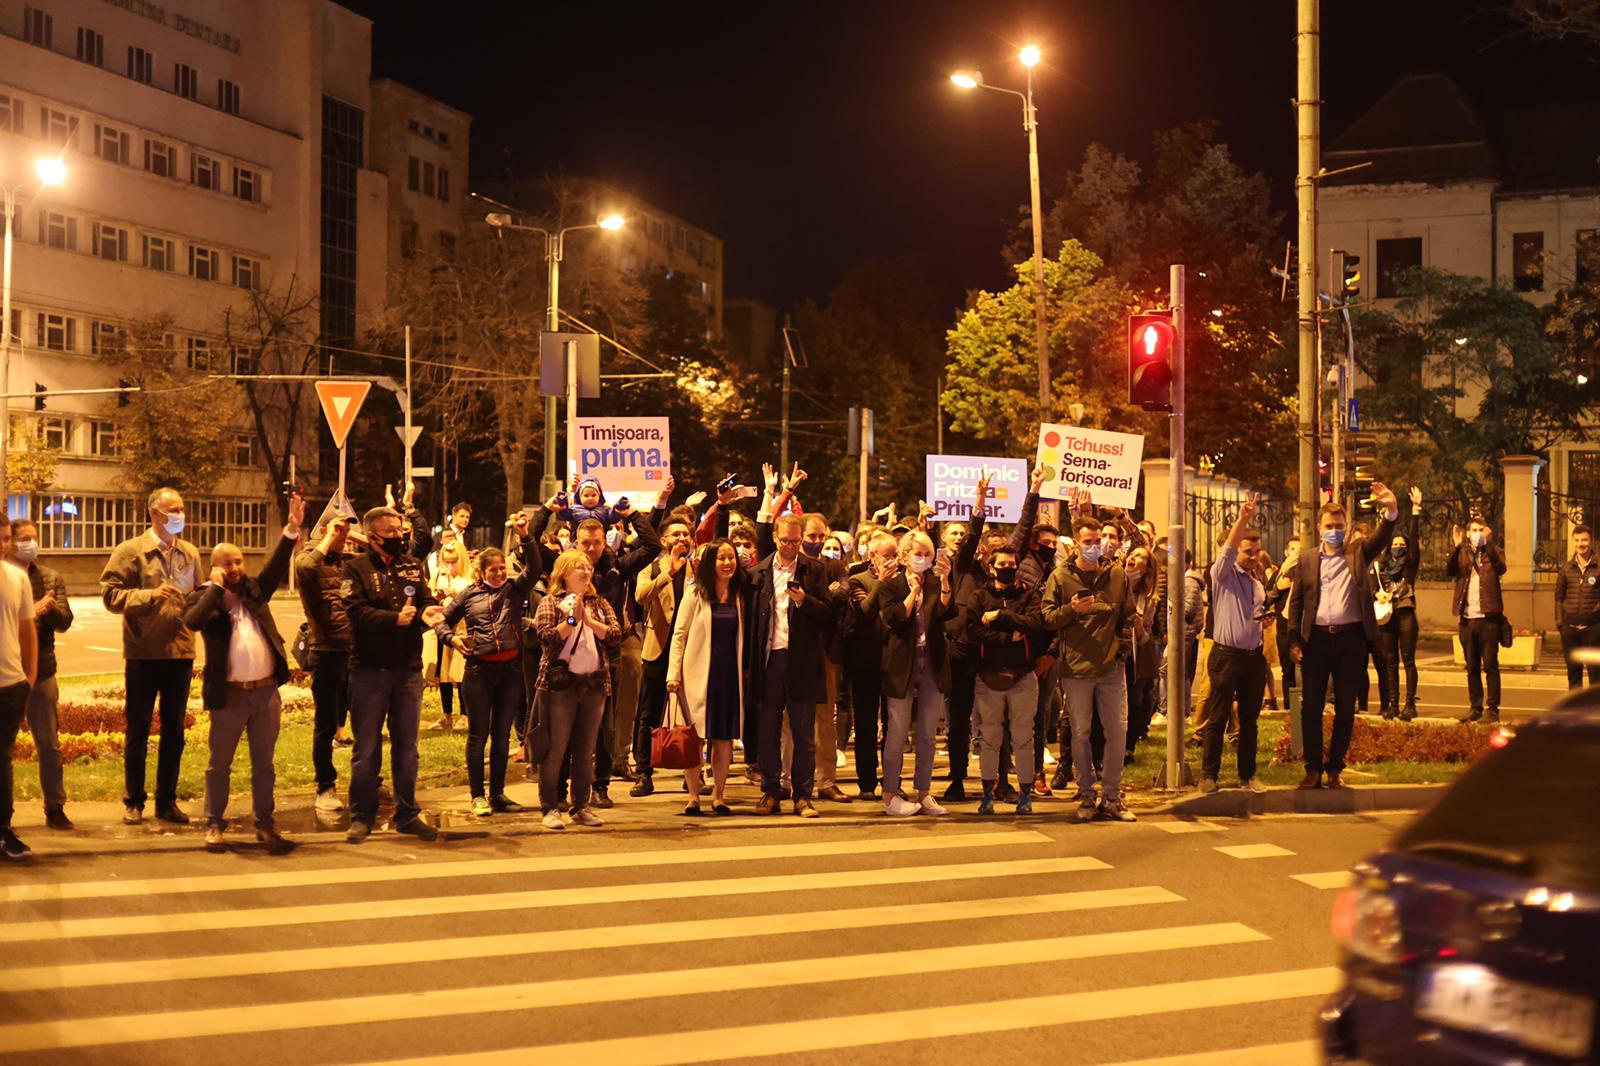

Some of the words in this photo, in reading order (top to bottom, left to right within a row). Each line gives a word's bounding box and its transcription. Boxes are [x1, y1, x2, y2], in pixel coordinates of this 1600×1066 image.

[579, 425, 664, 444] Timișoara,
[1065, 436, 1124, 456] Tchuss!
[582, 441, 668, 475] prima.
[1063, 452, 1111, 470] Sema-
[934, 462, 1019, 482] Dominic
[1061, 467, 1133, 490] forișoara!
